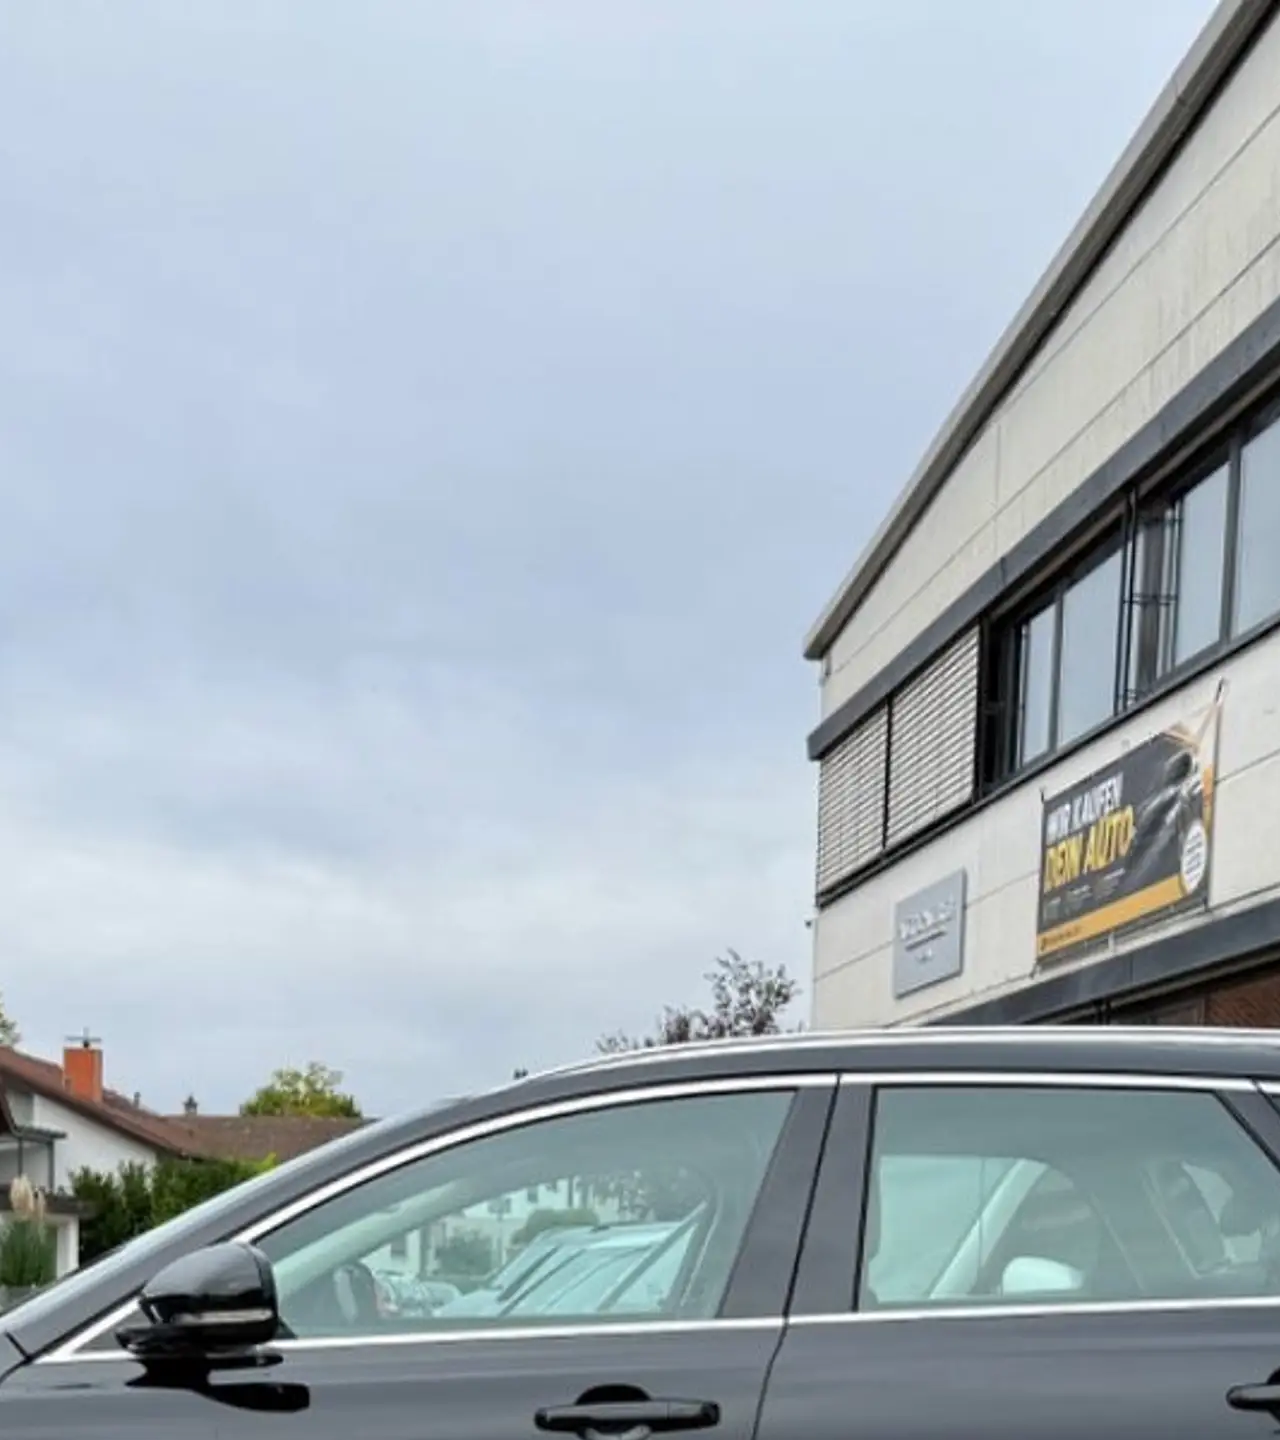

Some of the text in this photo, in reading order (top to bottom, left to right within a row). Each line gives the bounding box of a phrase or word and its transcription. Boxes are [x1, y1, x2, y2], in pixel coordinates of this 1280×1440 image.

[1043, 831, 1084, 895] DEIN
[1083, 803, 1136, 876] AUTO
[1046, 771, 1124, 846] WIR KAUFEN
